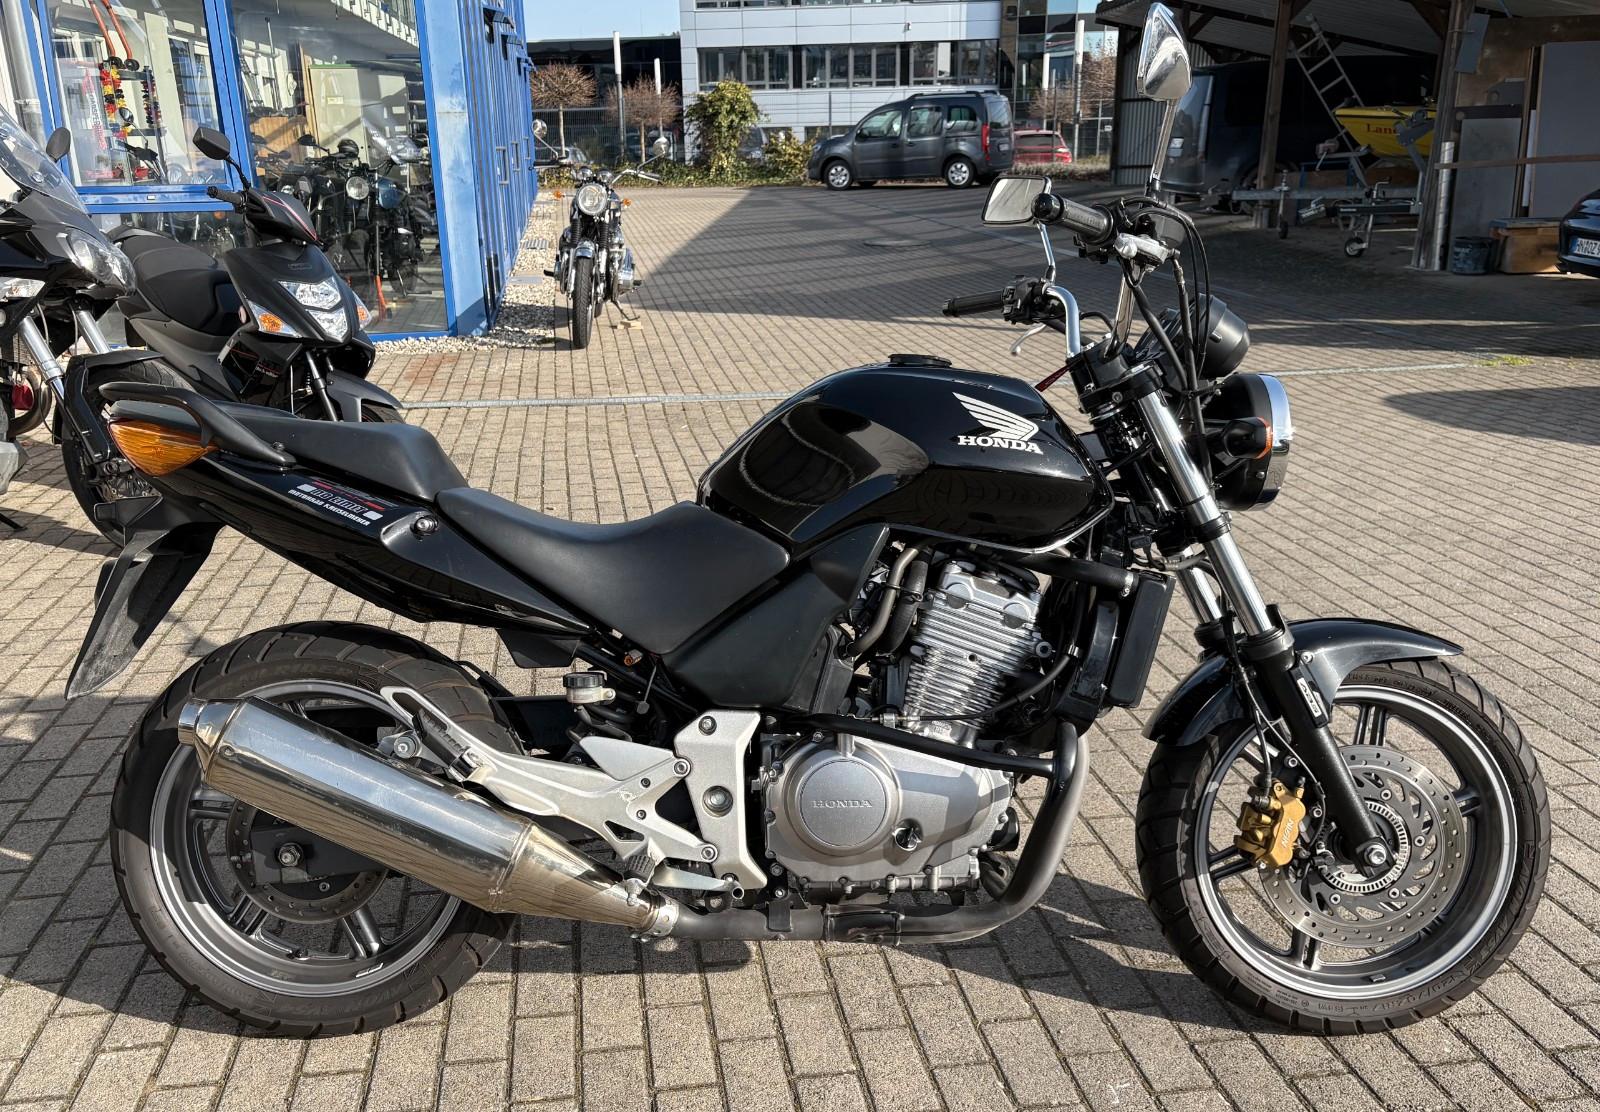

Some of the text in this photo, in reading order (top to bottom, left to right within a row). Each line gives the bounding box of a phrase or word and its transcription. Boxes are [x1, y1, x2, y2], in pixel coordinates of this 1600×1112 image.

[957, 435, 1044, 455] HONDA
[287, 489, 325, 506] MOTORRAD
[811, 799, 873, 809] HONDA
